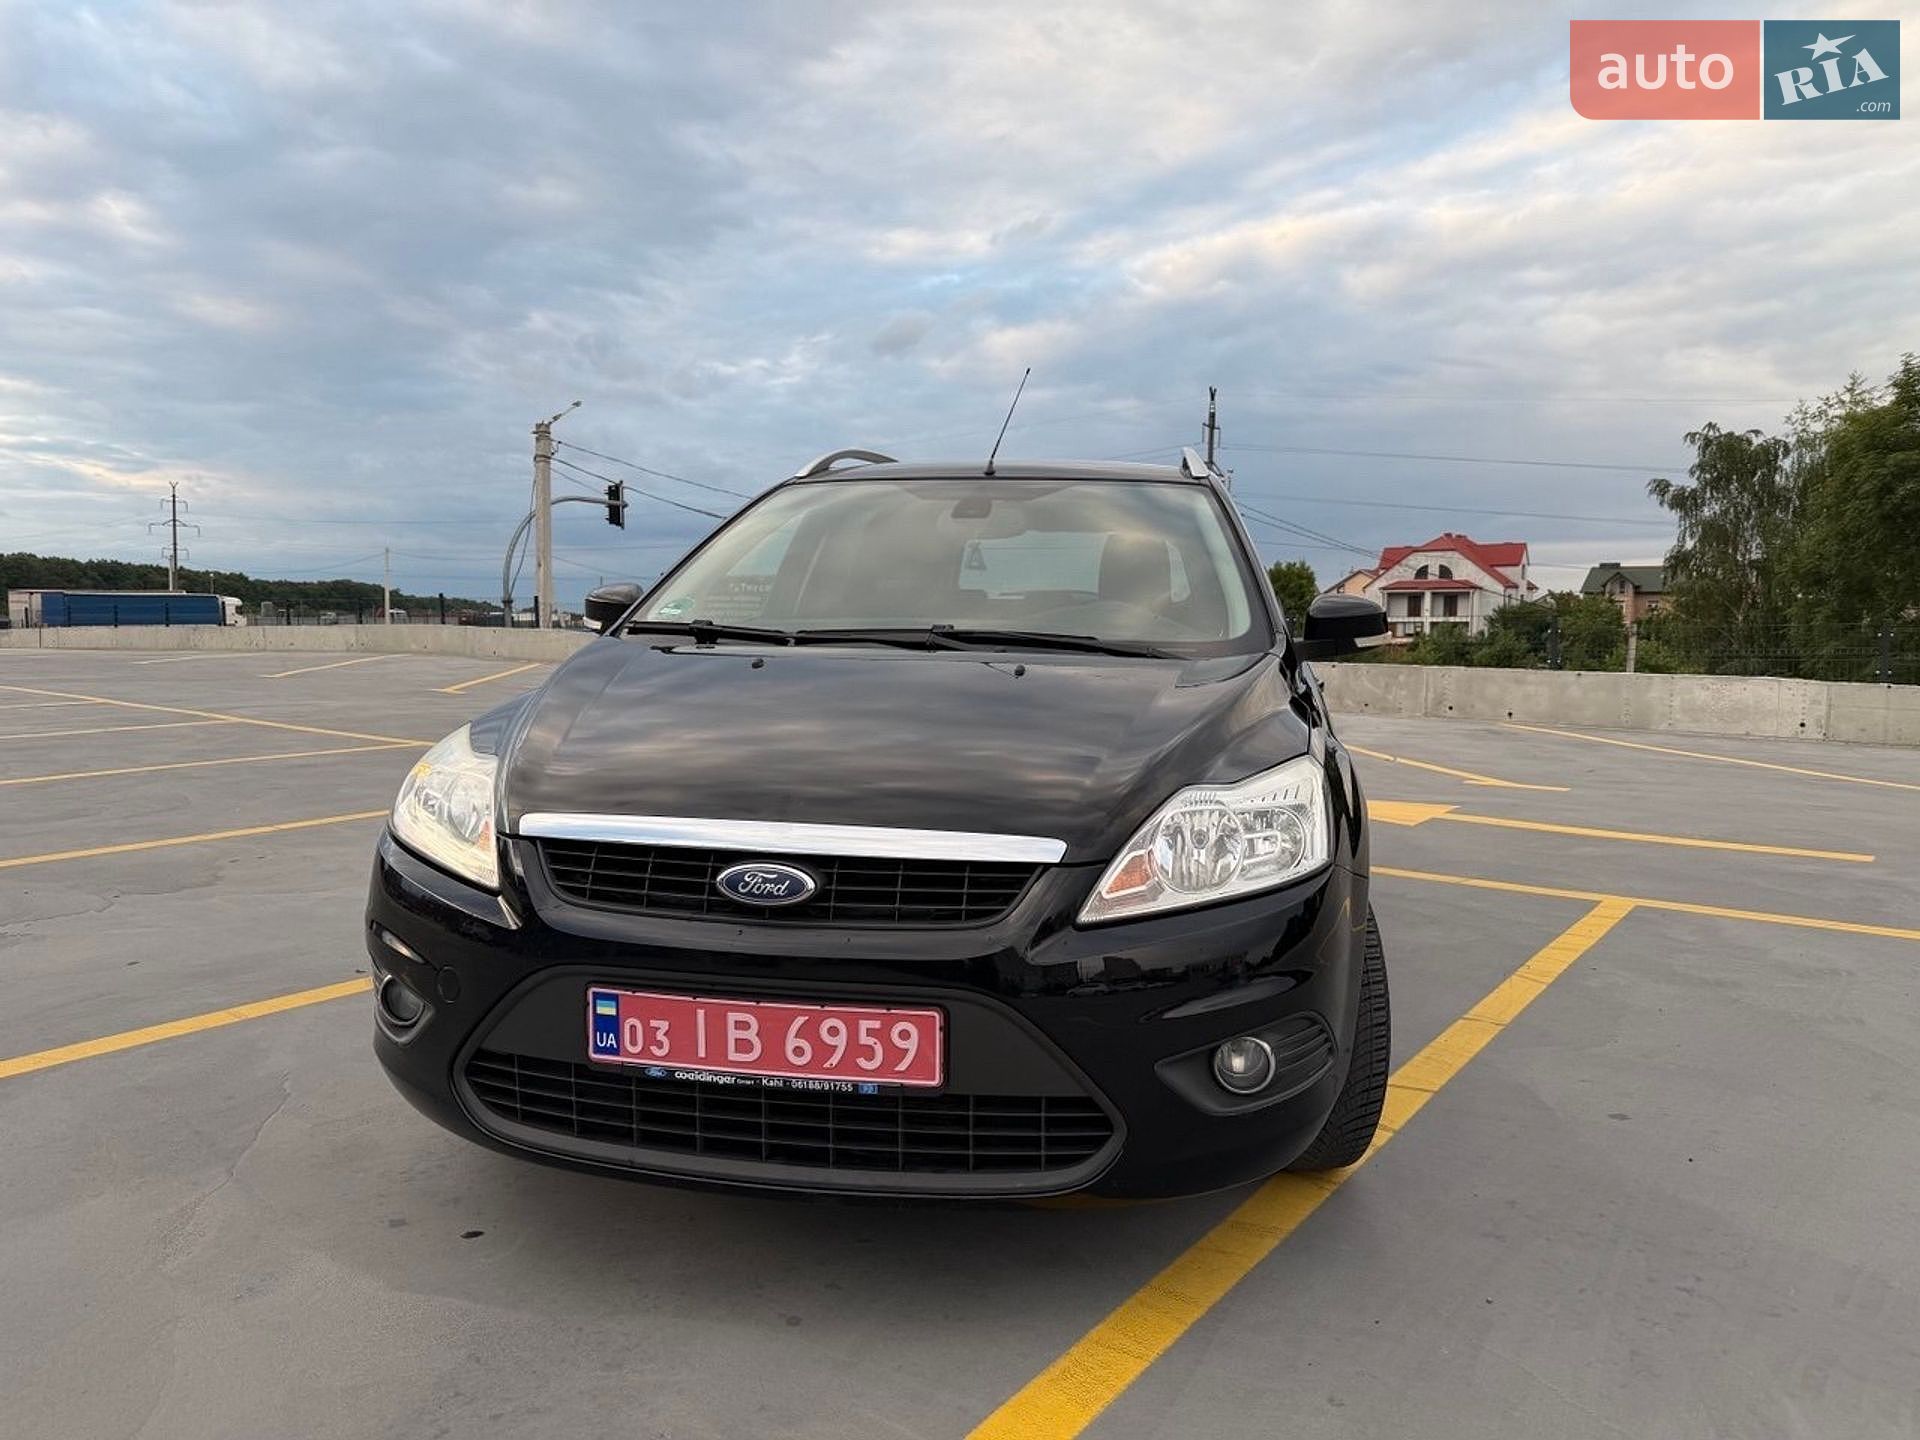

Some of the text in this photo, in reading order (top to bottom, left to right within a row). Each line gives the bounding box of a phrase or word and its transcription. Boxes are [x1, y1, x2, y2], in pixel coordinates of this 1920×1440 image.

[738, 871, 790, 896] Ford
[597, 1031, 617, 1049] UA
[623, 1016, 671, 1057] 03
[785, 1016, 919, 1071] 6959
